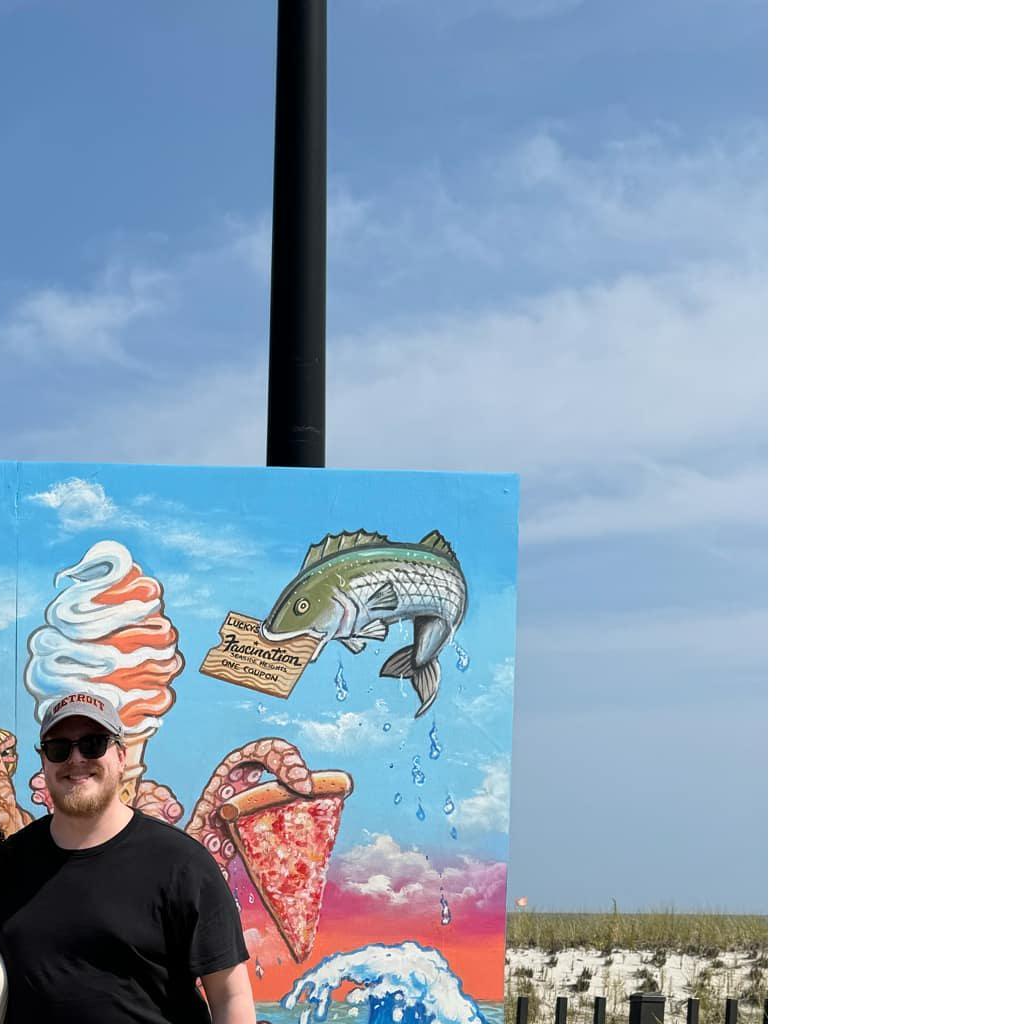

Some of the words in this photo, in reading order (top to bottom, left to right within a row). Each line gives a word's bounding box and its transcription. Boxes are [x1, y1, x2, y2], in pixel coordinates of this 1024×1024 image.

[223, 634, 302, 667] Fascination
[221, 659, 240, 671] ONE
[243, 665, 279, 682] COUPON
[53, 693, 105, 714] DETROIT
